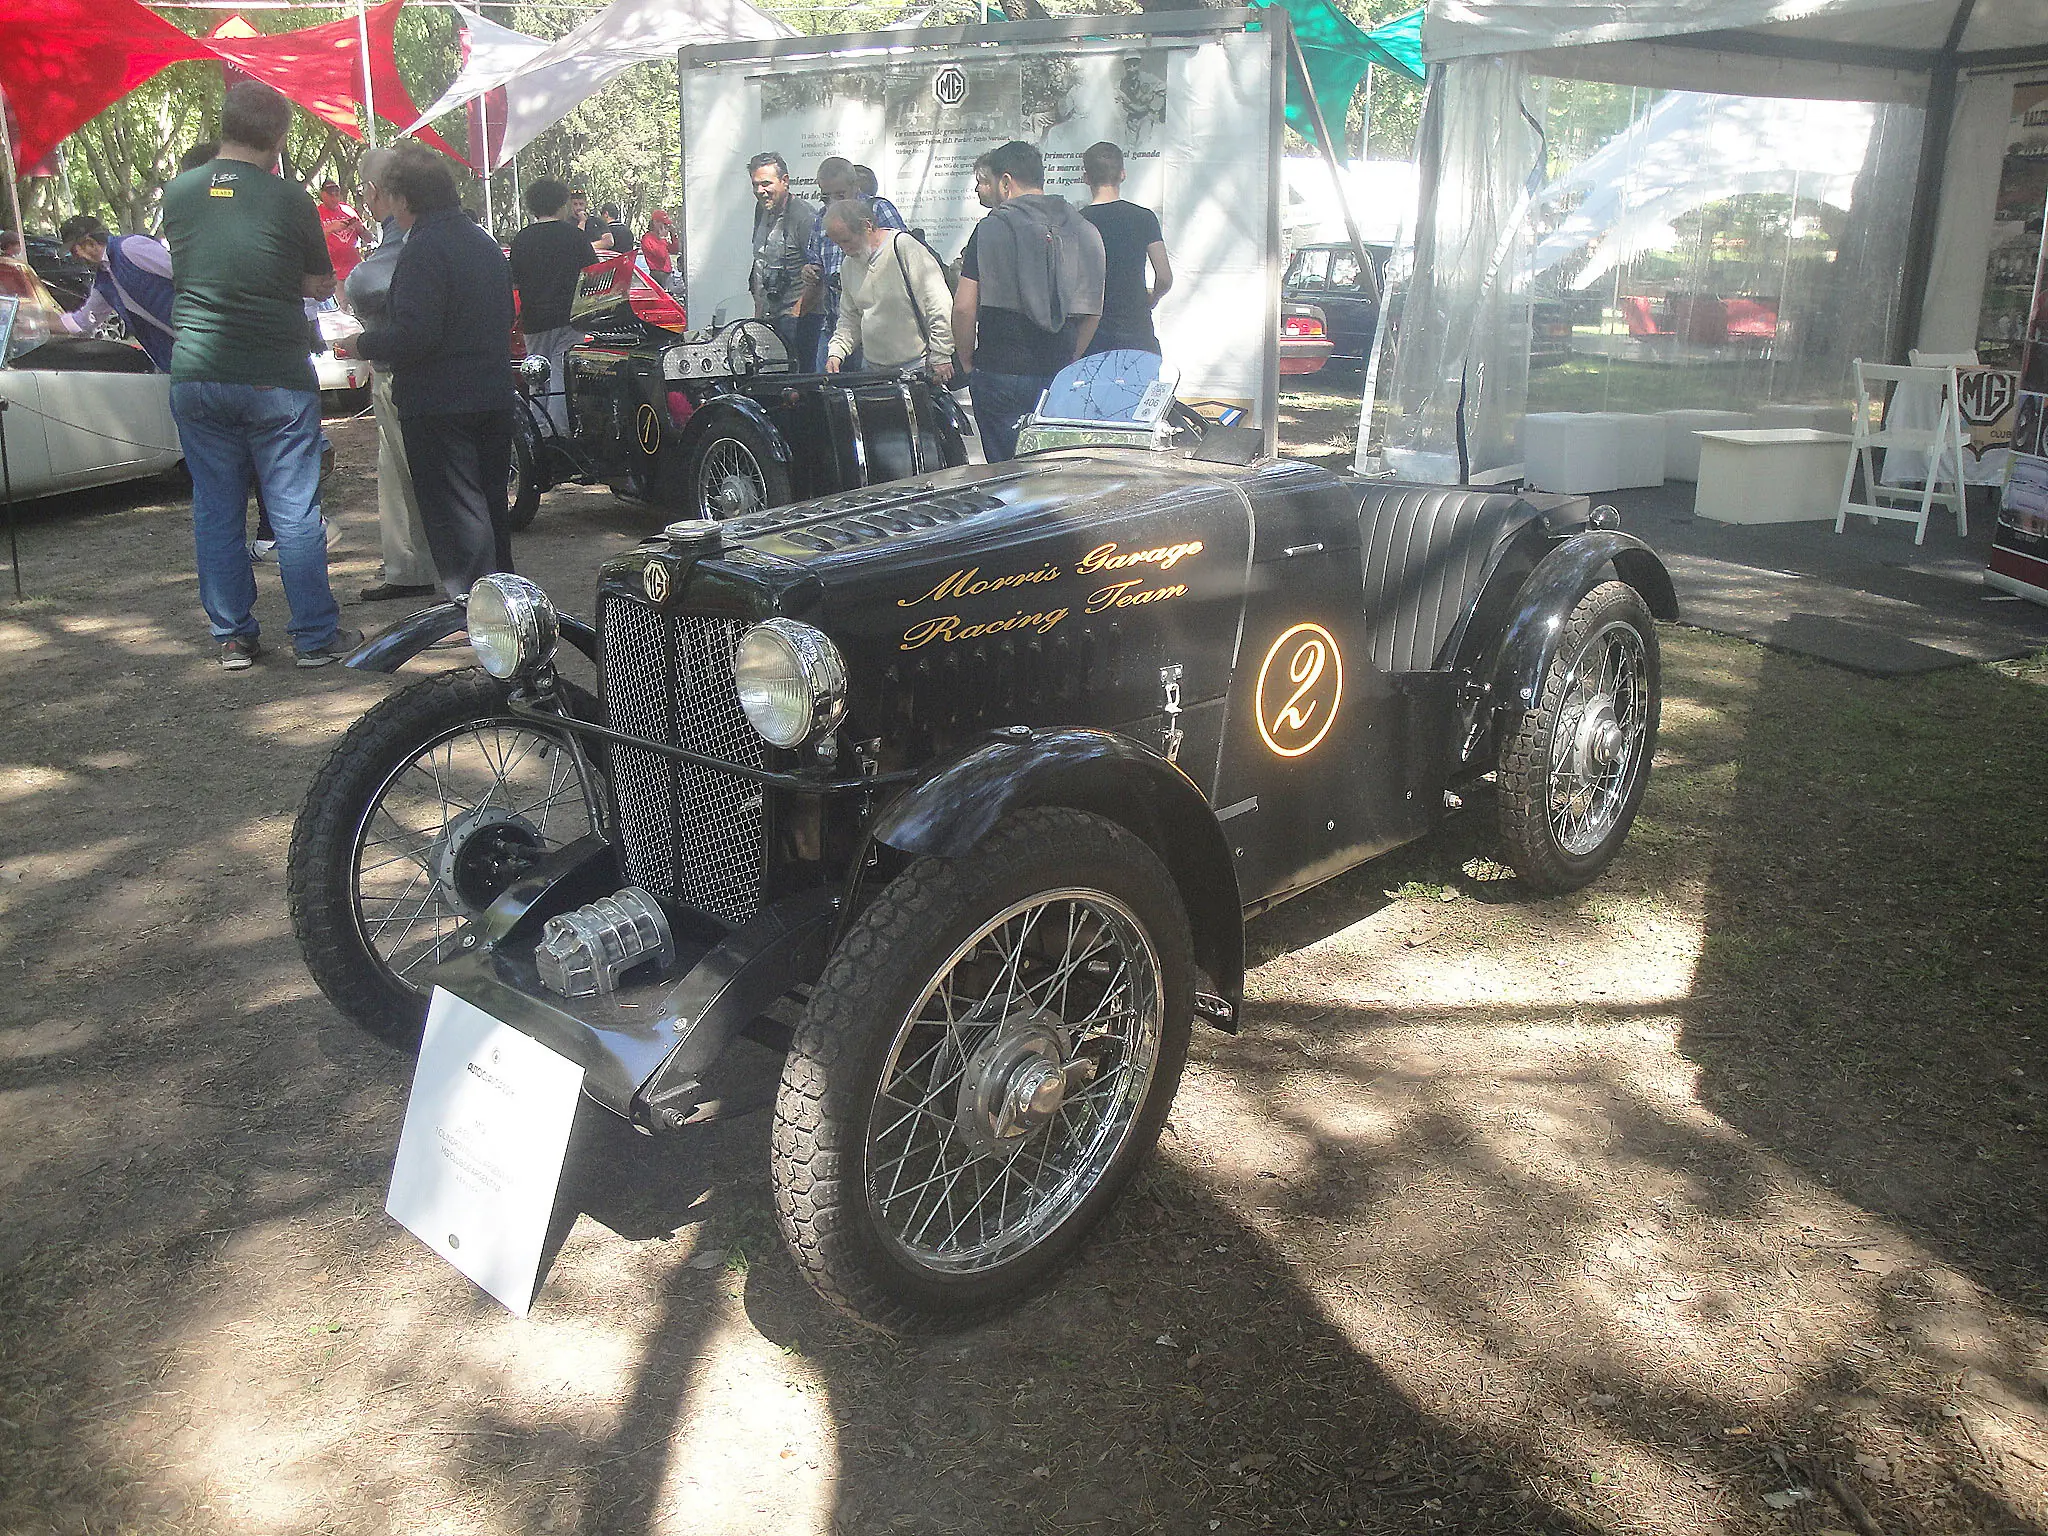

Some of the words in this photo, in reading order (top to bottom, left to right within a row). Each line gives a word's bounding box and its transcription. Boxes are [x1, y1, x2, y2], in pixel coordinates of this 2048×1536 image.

[939, 72, 963, 101] MG
[1044, 149, 1075, 161] primera
[1132, 150, 1160, 160] ganada
[1048, 163, 1056, 172] la
[1057, 164, 1081, 172] marca
[1056, 176, 1085, 187] Argenti
[1143, 398, 1160, 408] 406
[1962, 373, 2007, 417] MG
[643, 411, 653, 443] 1
[1990, 430, 2012, 439] CLUB
[897, 563, 1062, 607] Morris
[1075, 541, 1204, 575] Garage
[900, 607, 1069, 651] Racing
[1084, 578, 1190, 614] Team
[1272, 639, 1327, 735] 2
